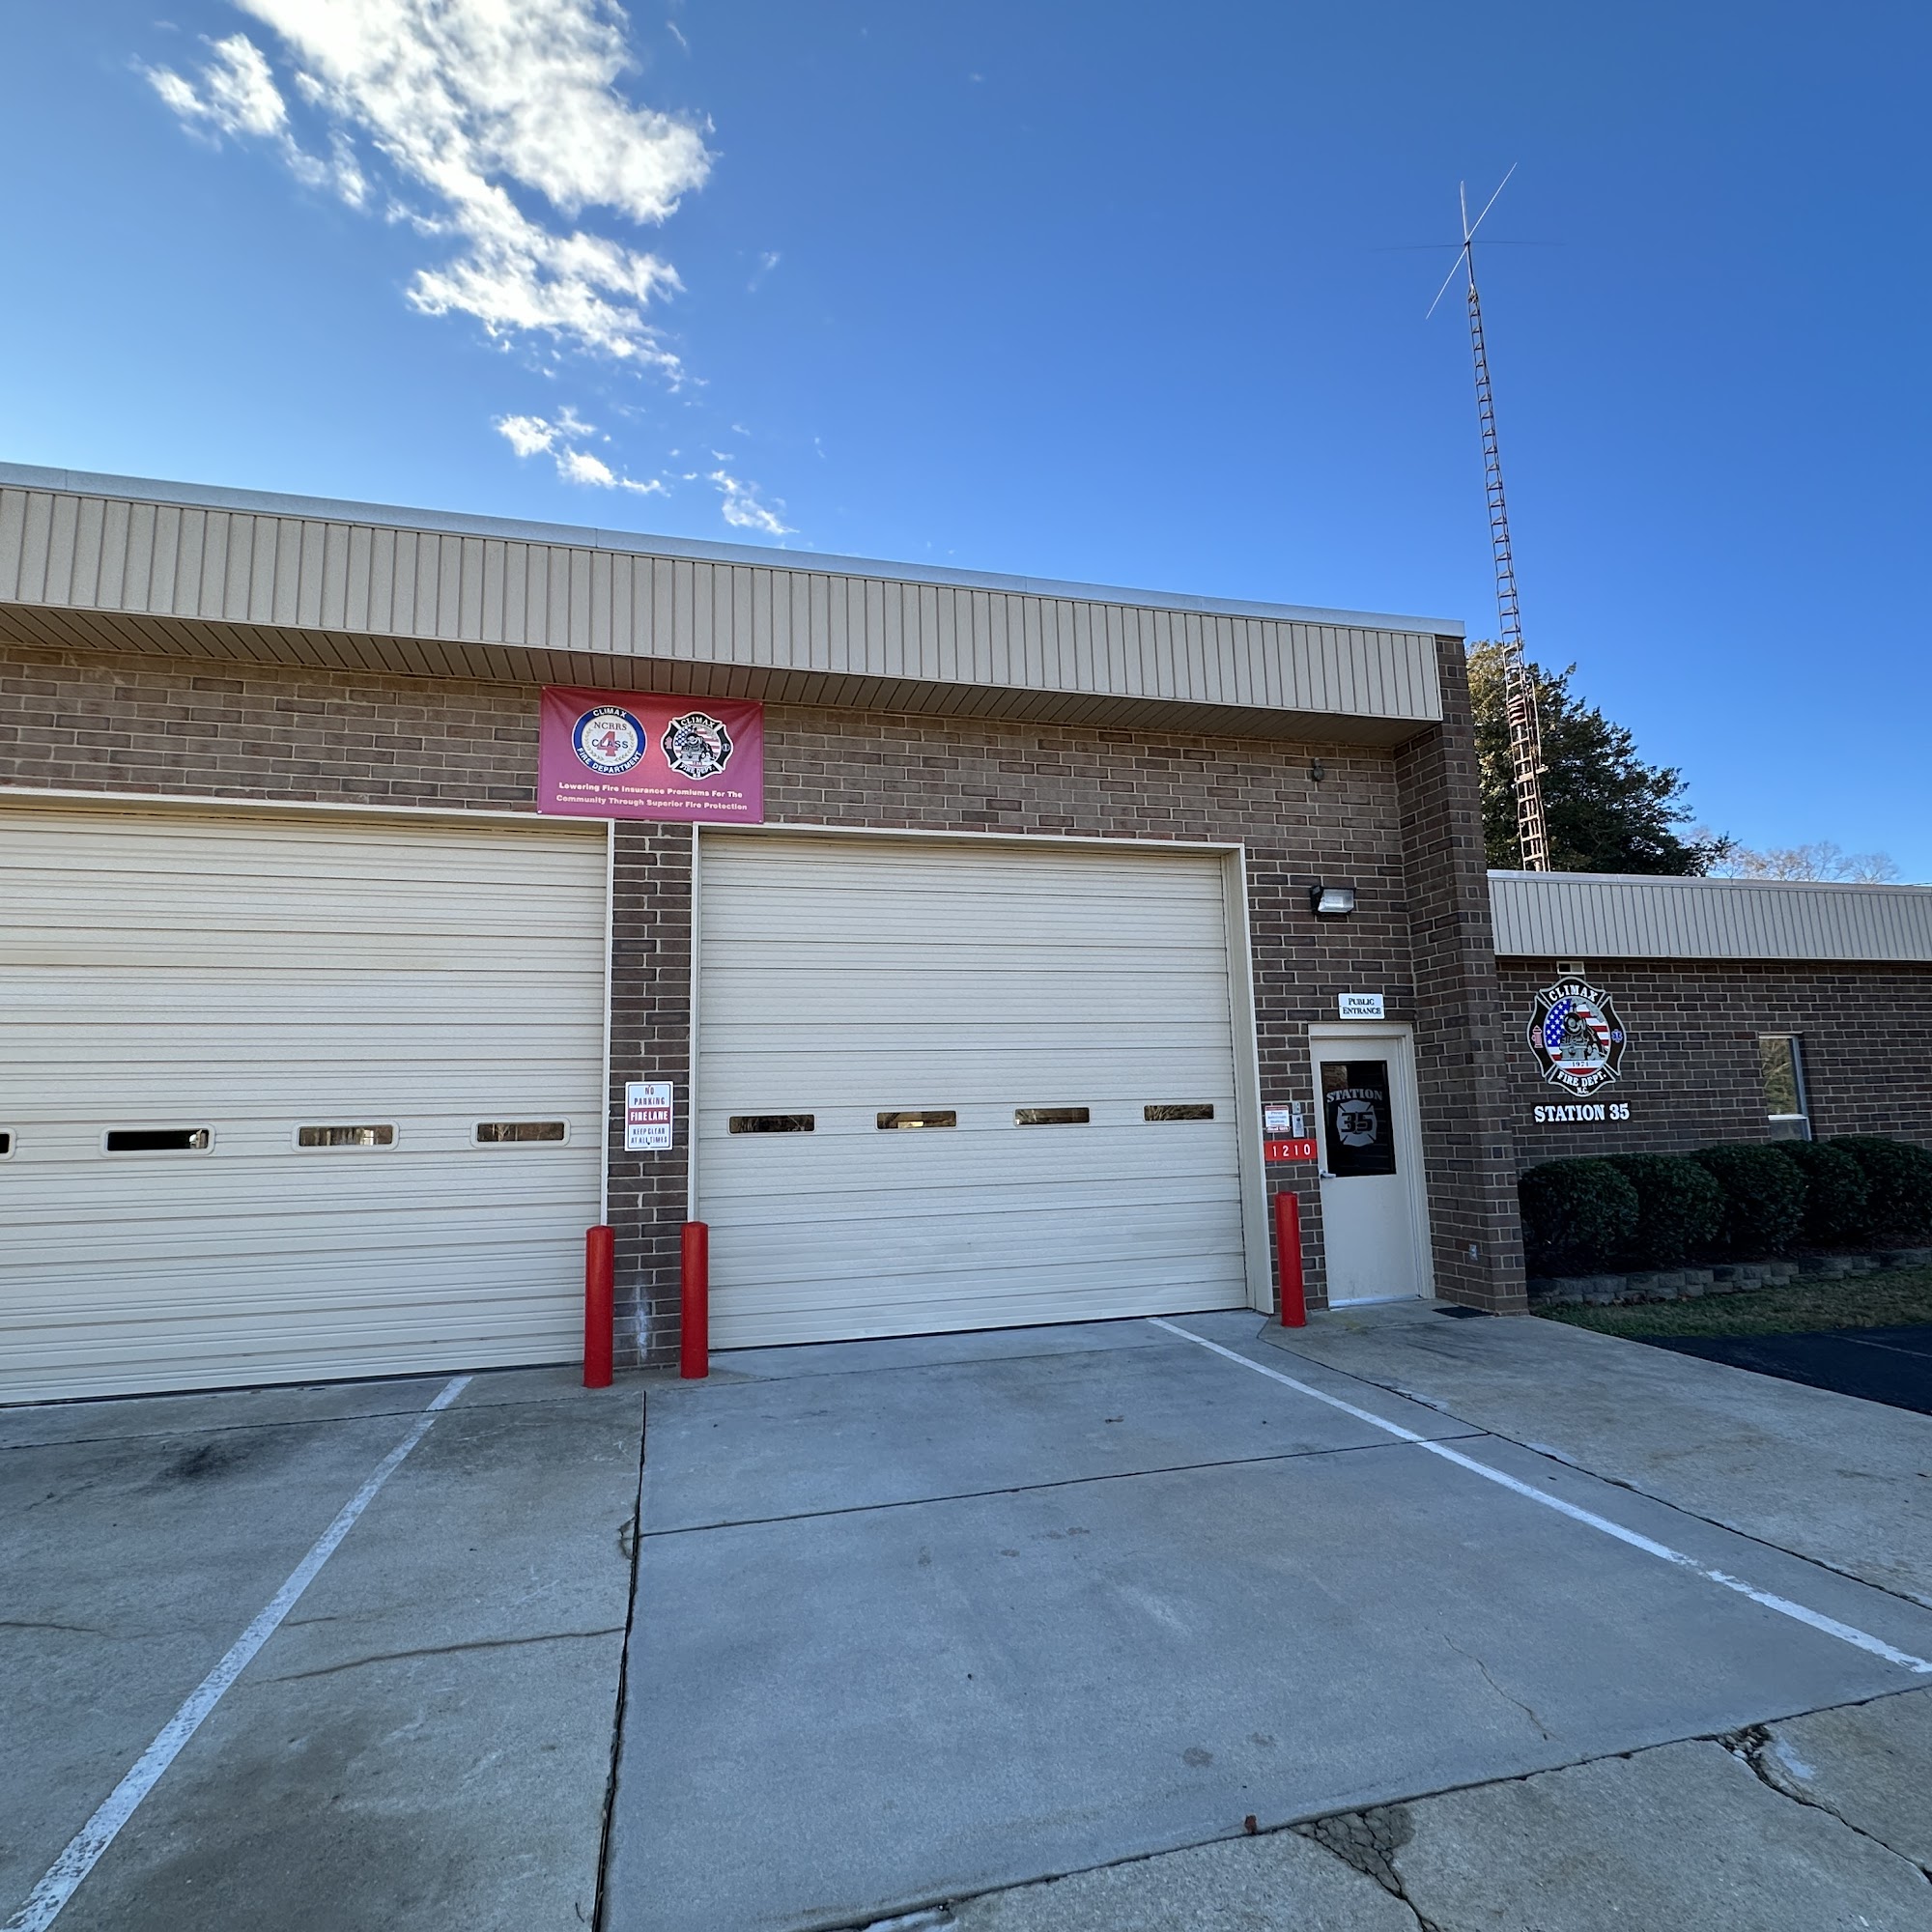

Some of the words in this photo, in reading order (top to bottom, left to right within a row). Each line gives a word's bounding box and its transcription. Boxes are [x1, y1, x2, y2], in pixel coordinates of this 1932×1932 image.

[593, 706, 627, 719] CLIMAX
[593, 722, 628, 731] NCRRS
[680, 717, 716, 728] CLIMAX
[591, 738, 629, 749] CLASS
[597, 730, 619, 756] 4
[577, 747, 591, 765] FIRE
[591, 752, 642, 773] DEPARTMENT
[558, 781, 600, 792] Lowering
[602, 783, 620, 792] Fire
[621, 785, 666, 795] Insurance
[667, 787, 710, 797] Premiums
[556, 794, 607, 806] Community
[609, 797, 645, 807] Through
[646, 799, 684, 809] Superior
[685, 801, 702, 810] Fire
[703, 802, 748, 810] Protection
[1548, 984, 1599, 1003] CLIMAX
[1343, 1007, 1382, 1015] ENTRANCE
[1556, 1070, 1579, 1086] FIRE
[1581, 1072, 1607, 1087] DEPT.
[1326, 1088, 1383, 1103] STATION
[630, 1111, 647, 1121] FIRE
[648, 1111, 668, 1120] LANE
[1534, 1104, 1605, 1122] STATION
[1608, 1102, 1631, 1122] 35
[1341, 1111, 1374, 1133] 35
[1271, 1144, 1311, 1157] 1210
